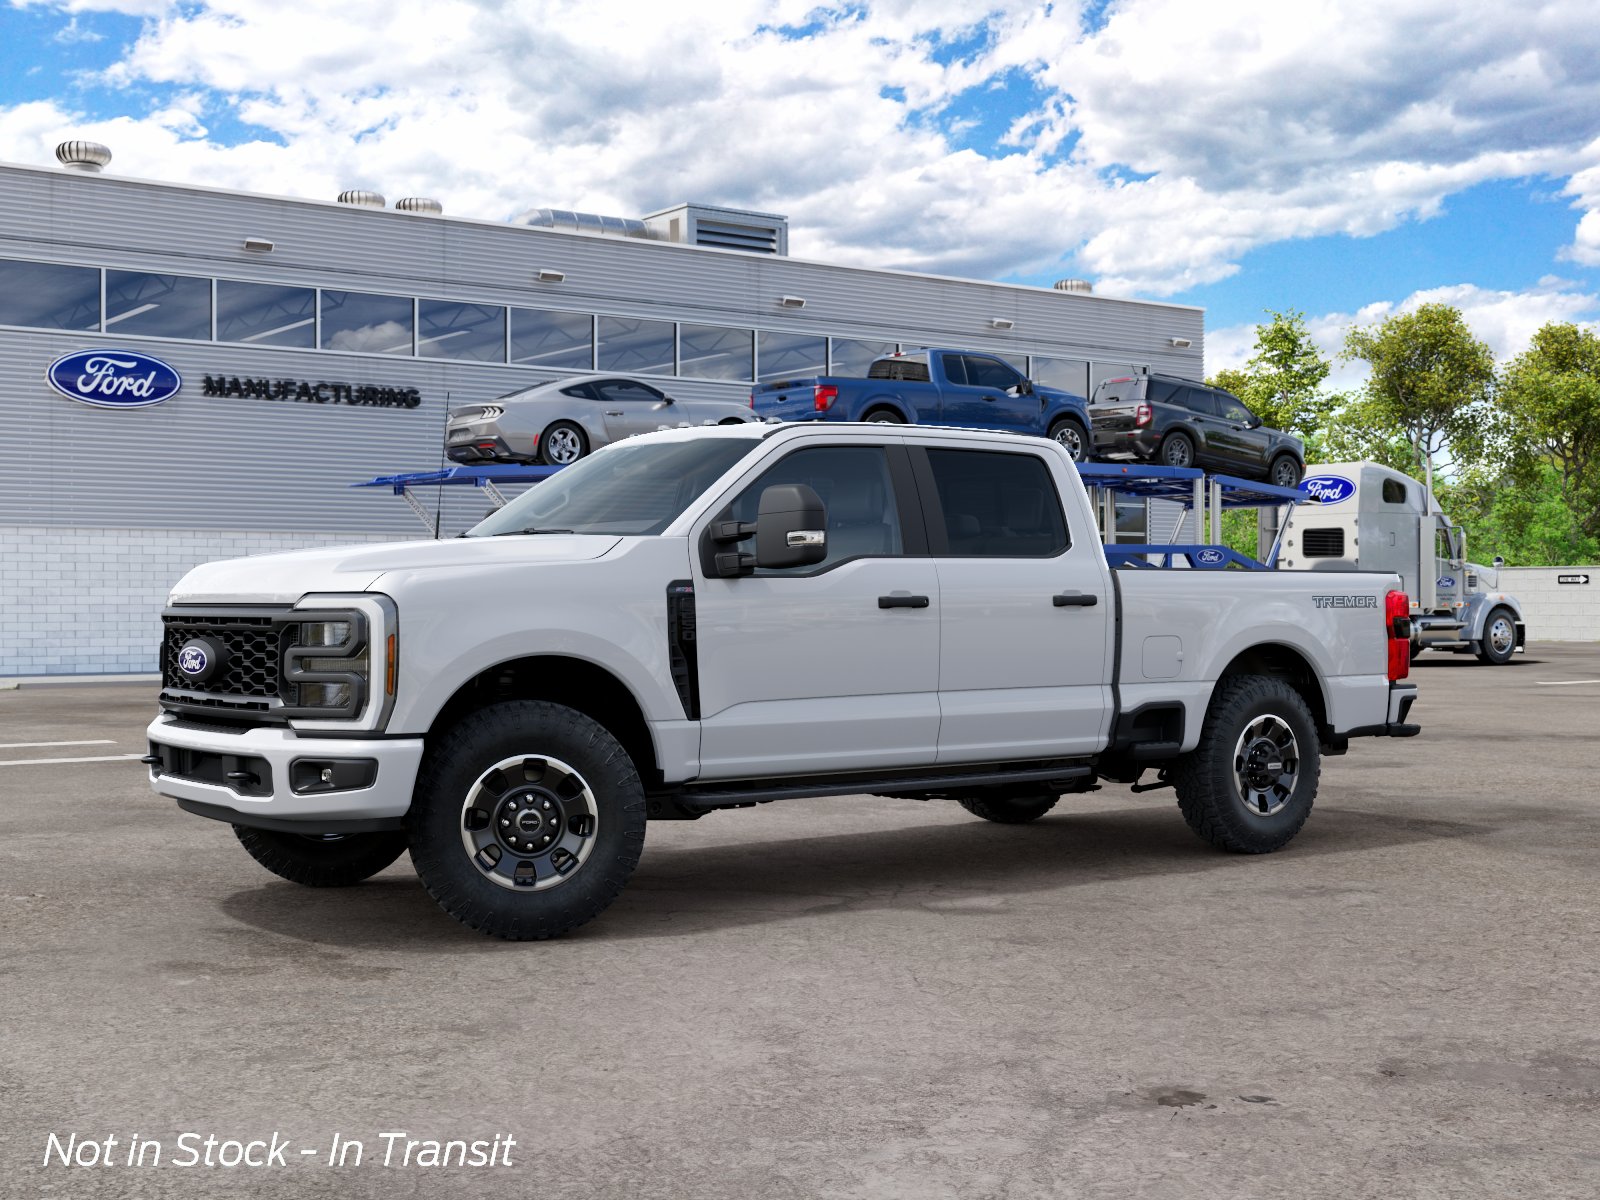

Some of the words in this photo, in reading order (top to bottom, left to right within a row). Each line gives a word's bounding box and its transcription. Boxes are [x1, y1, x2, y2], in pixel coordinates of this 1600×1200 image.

[77, 357, 156, 397] Ford
[203, 375, 421, 408] MANUFACTURING
[1307, 480, 1343, 499] Ford
[1201, 550, 1219, 561] Ford
[1312, 595, 1378, 608] TREMOR
[183, 650, 201, 670] Ford
